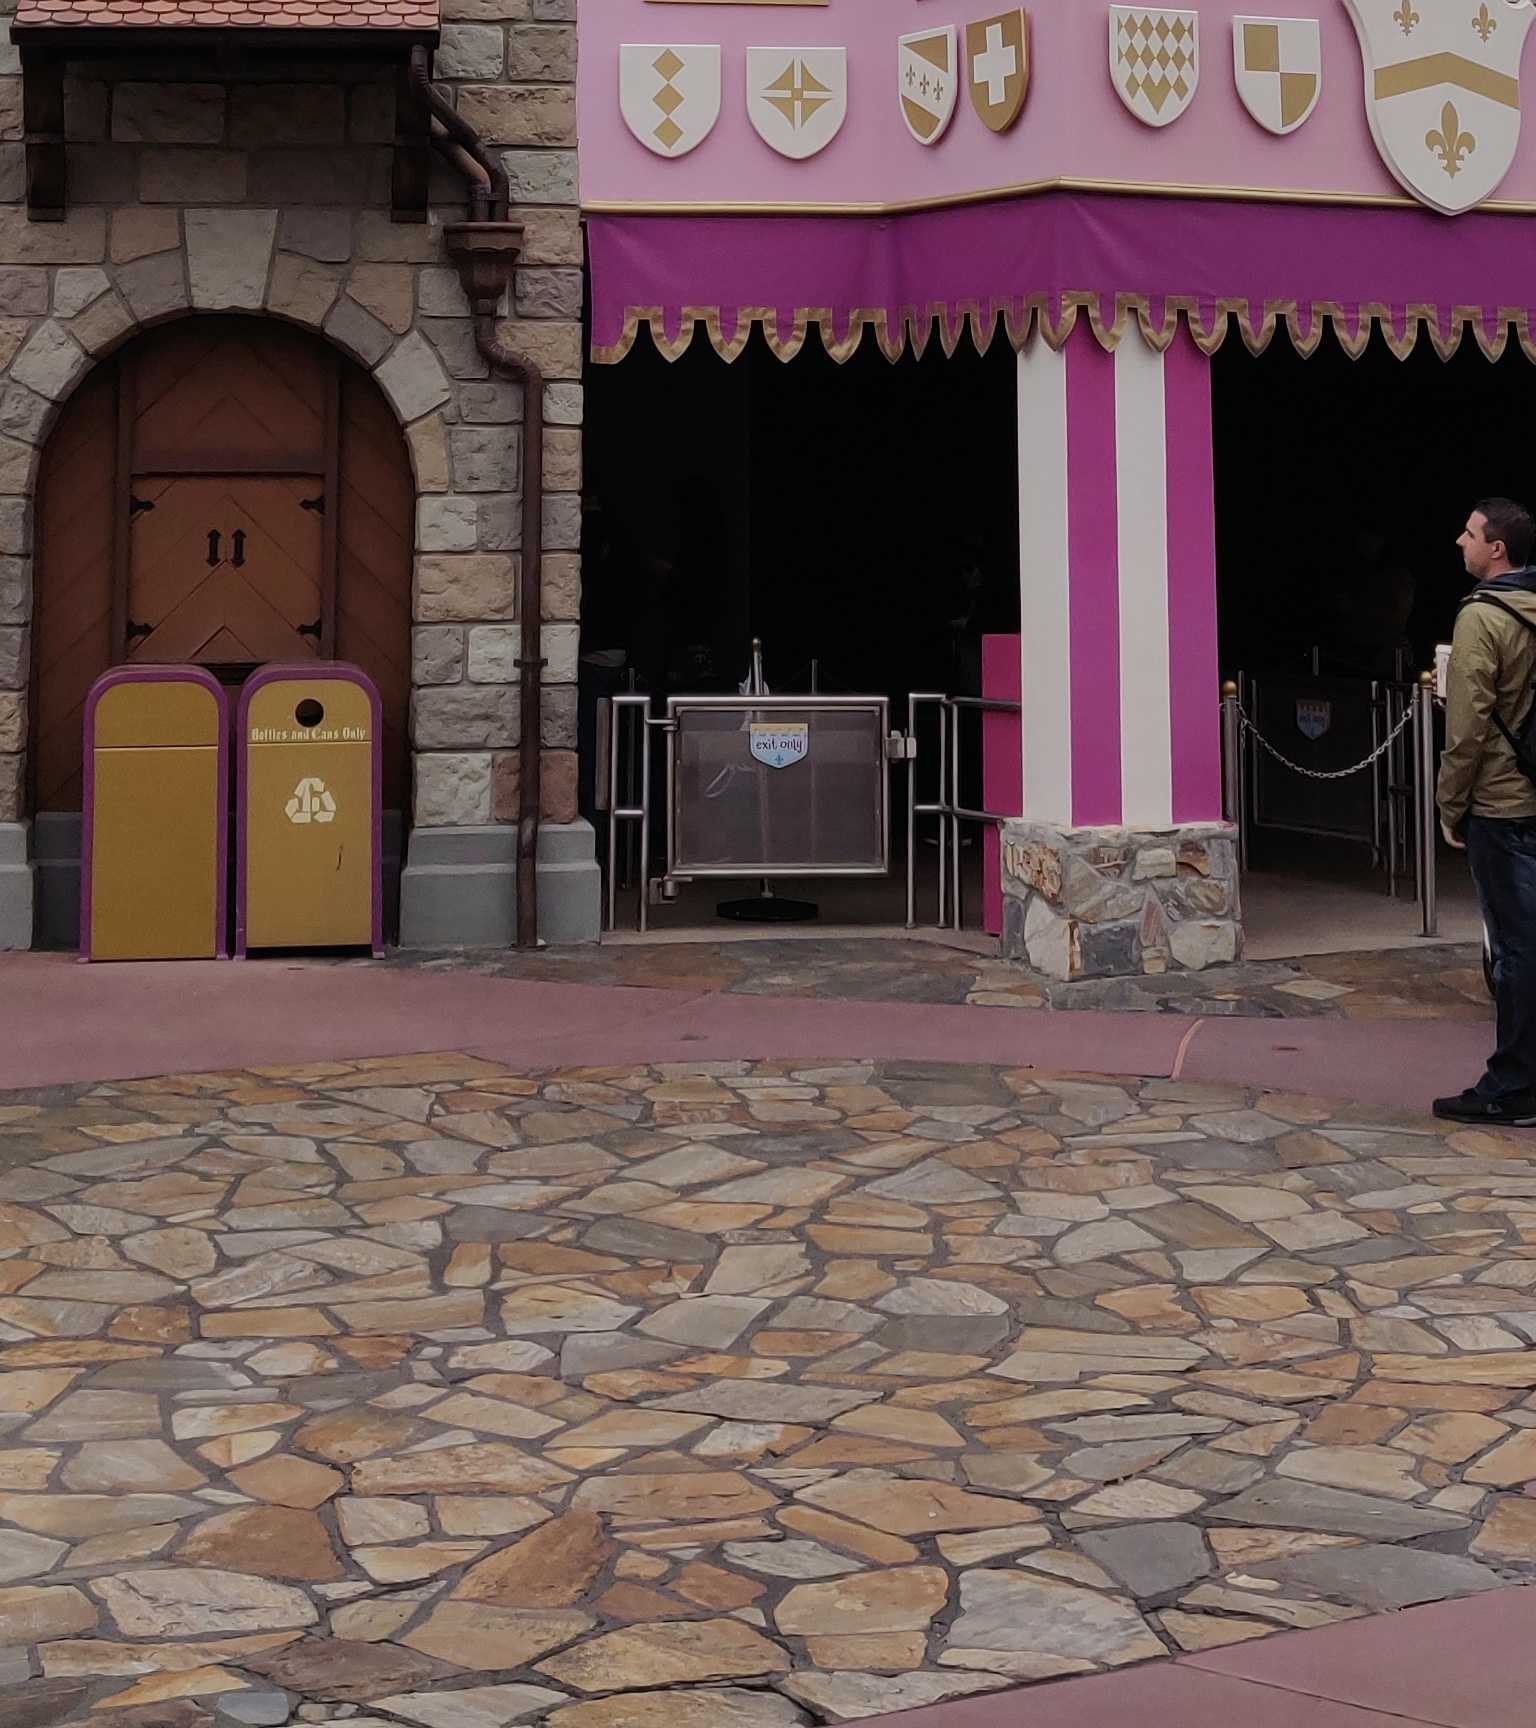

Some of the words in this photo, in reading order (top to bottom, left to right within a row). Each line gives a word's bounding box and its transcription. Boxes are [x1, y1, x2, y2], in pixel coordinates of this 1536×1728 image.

[251, 727, 290, 742] Bottles
[291, 728, 310, 741] and
[311, 726, 340, 741] Cans
[342, 726, 367, 741] Only
[756, 738, 777, 750] exit
[779, 738, 802, 754] only
